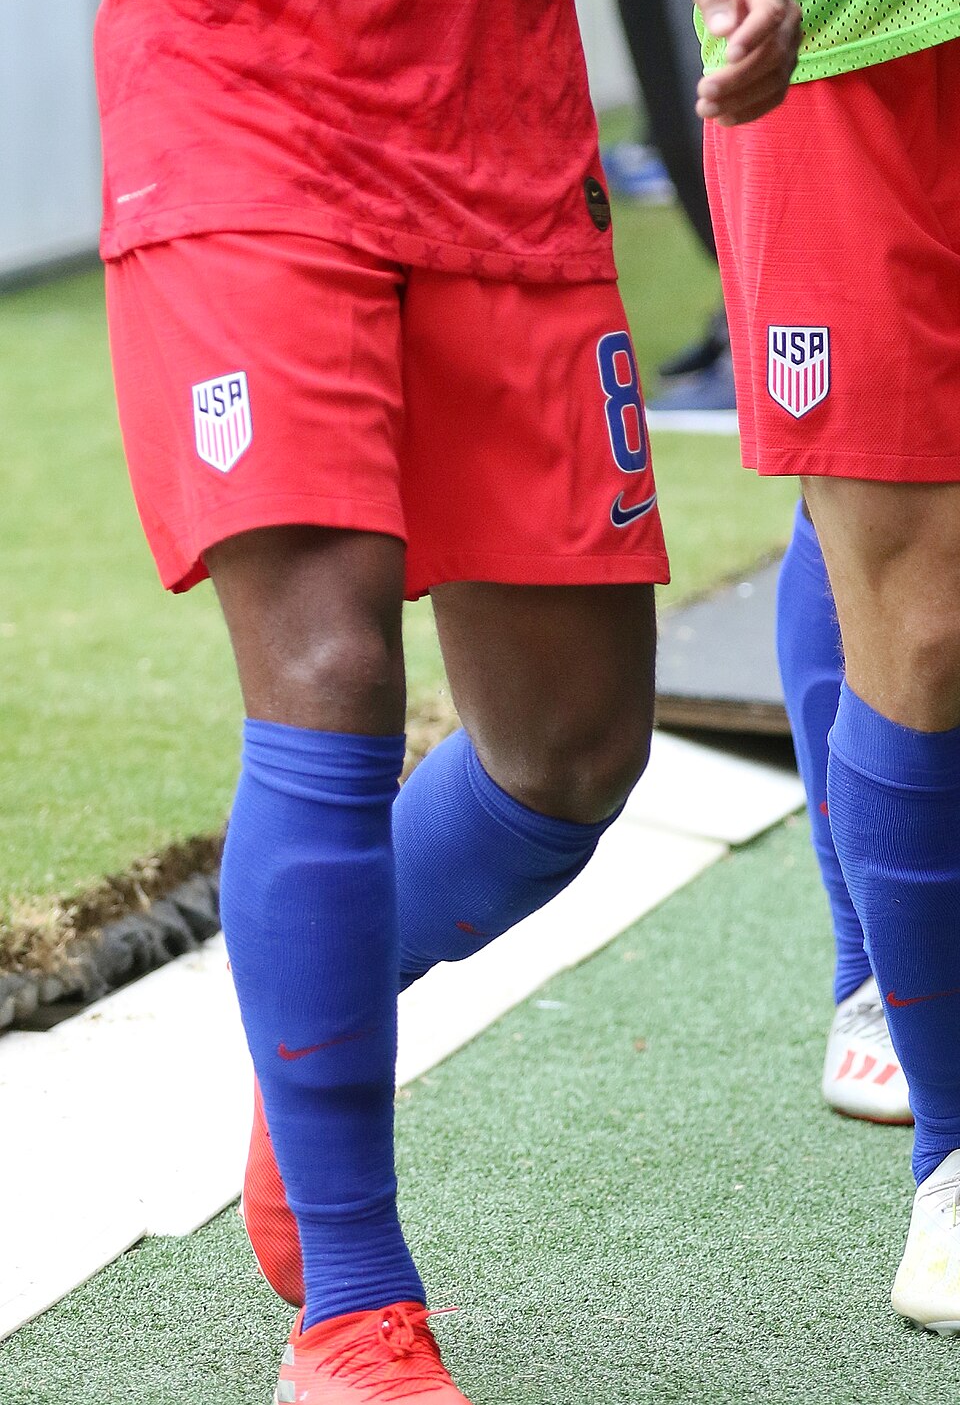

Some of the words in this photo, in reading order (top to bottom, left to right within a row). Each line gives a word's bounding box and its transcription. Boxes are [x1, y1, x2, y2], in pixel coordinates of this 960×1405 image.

[773, 331, 824, 366] USA
[197, 378, 242, 418] USA
[596, 330, 648, 473] 8
